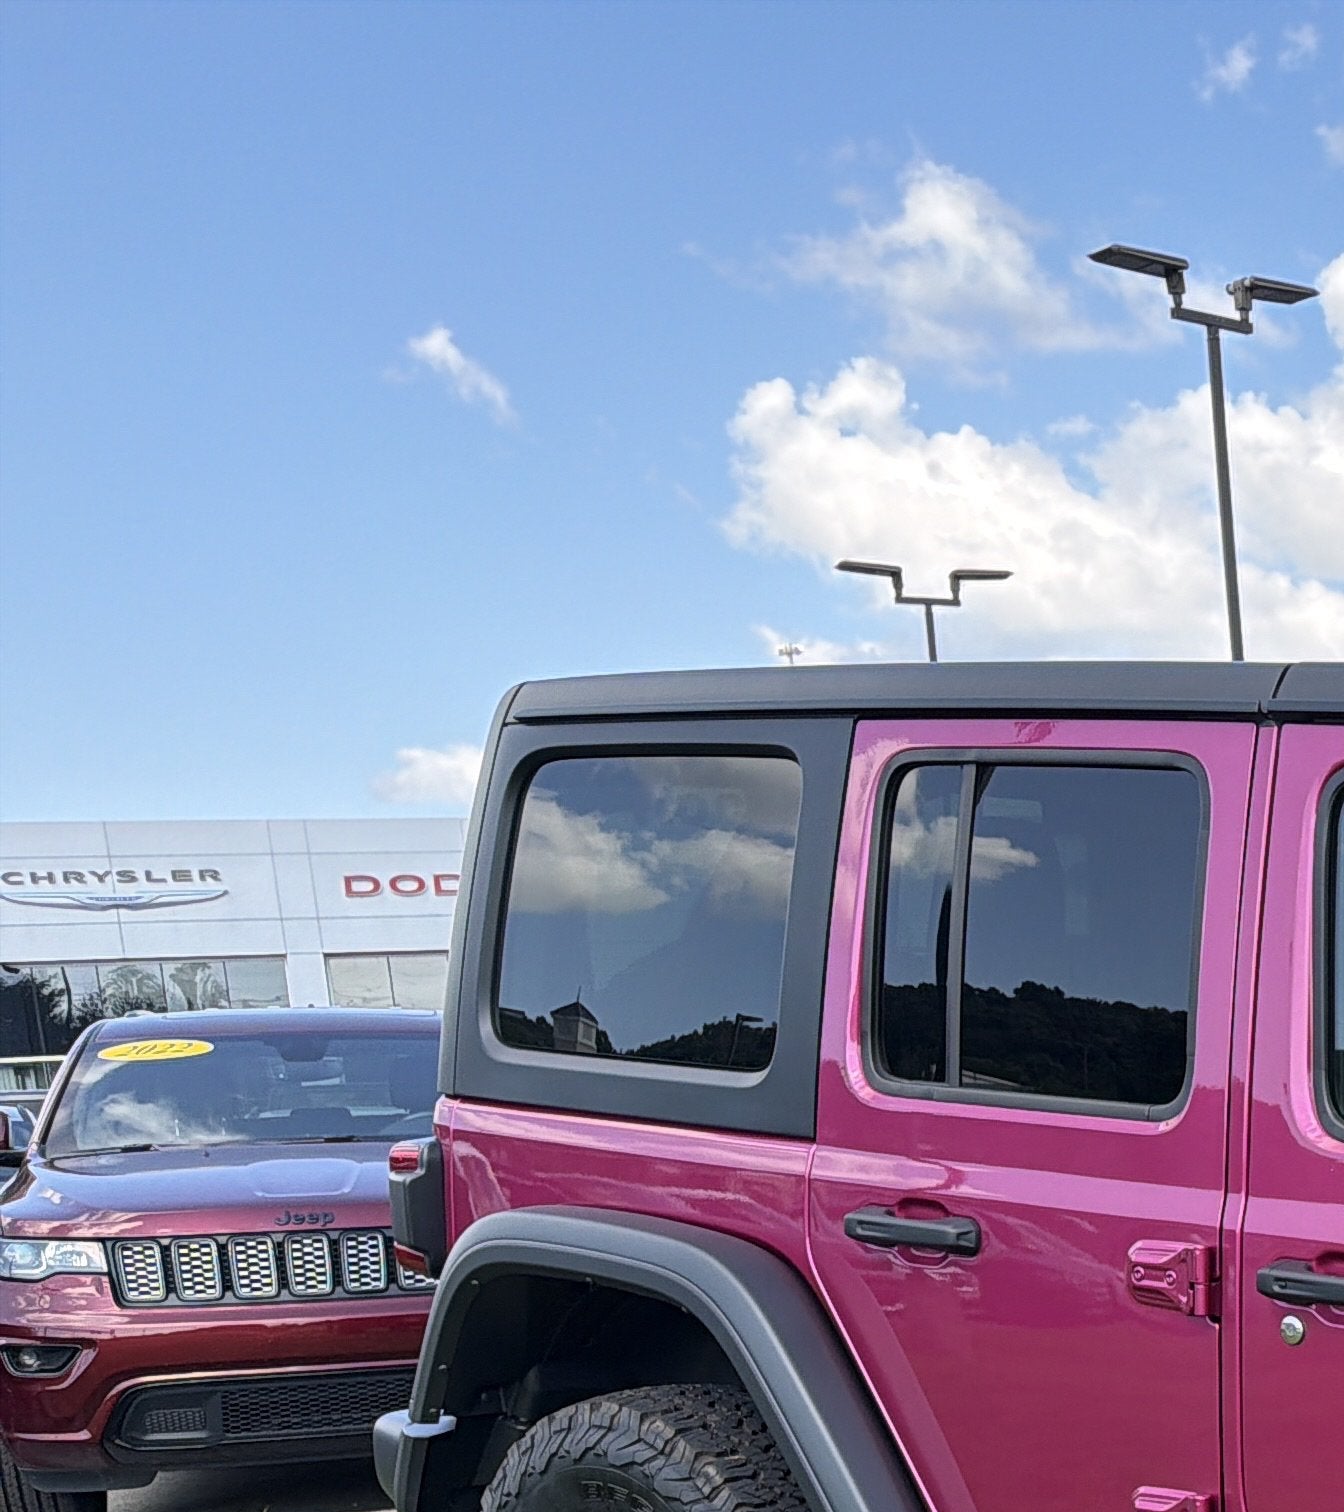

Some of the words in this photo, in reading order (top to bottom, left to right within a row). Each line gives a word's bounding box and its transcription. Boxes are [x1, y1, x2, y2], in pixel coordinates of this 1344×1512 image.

[1, 868, 223, 886] CHRYSLER
[114, 1042, 194, 1057] 2022
[274, 1210, 336, 1228] Jeep
